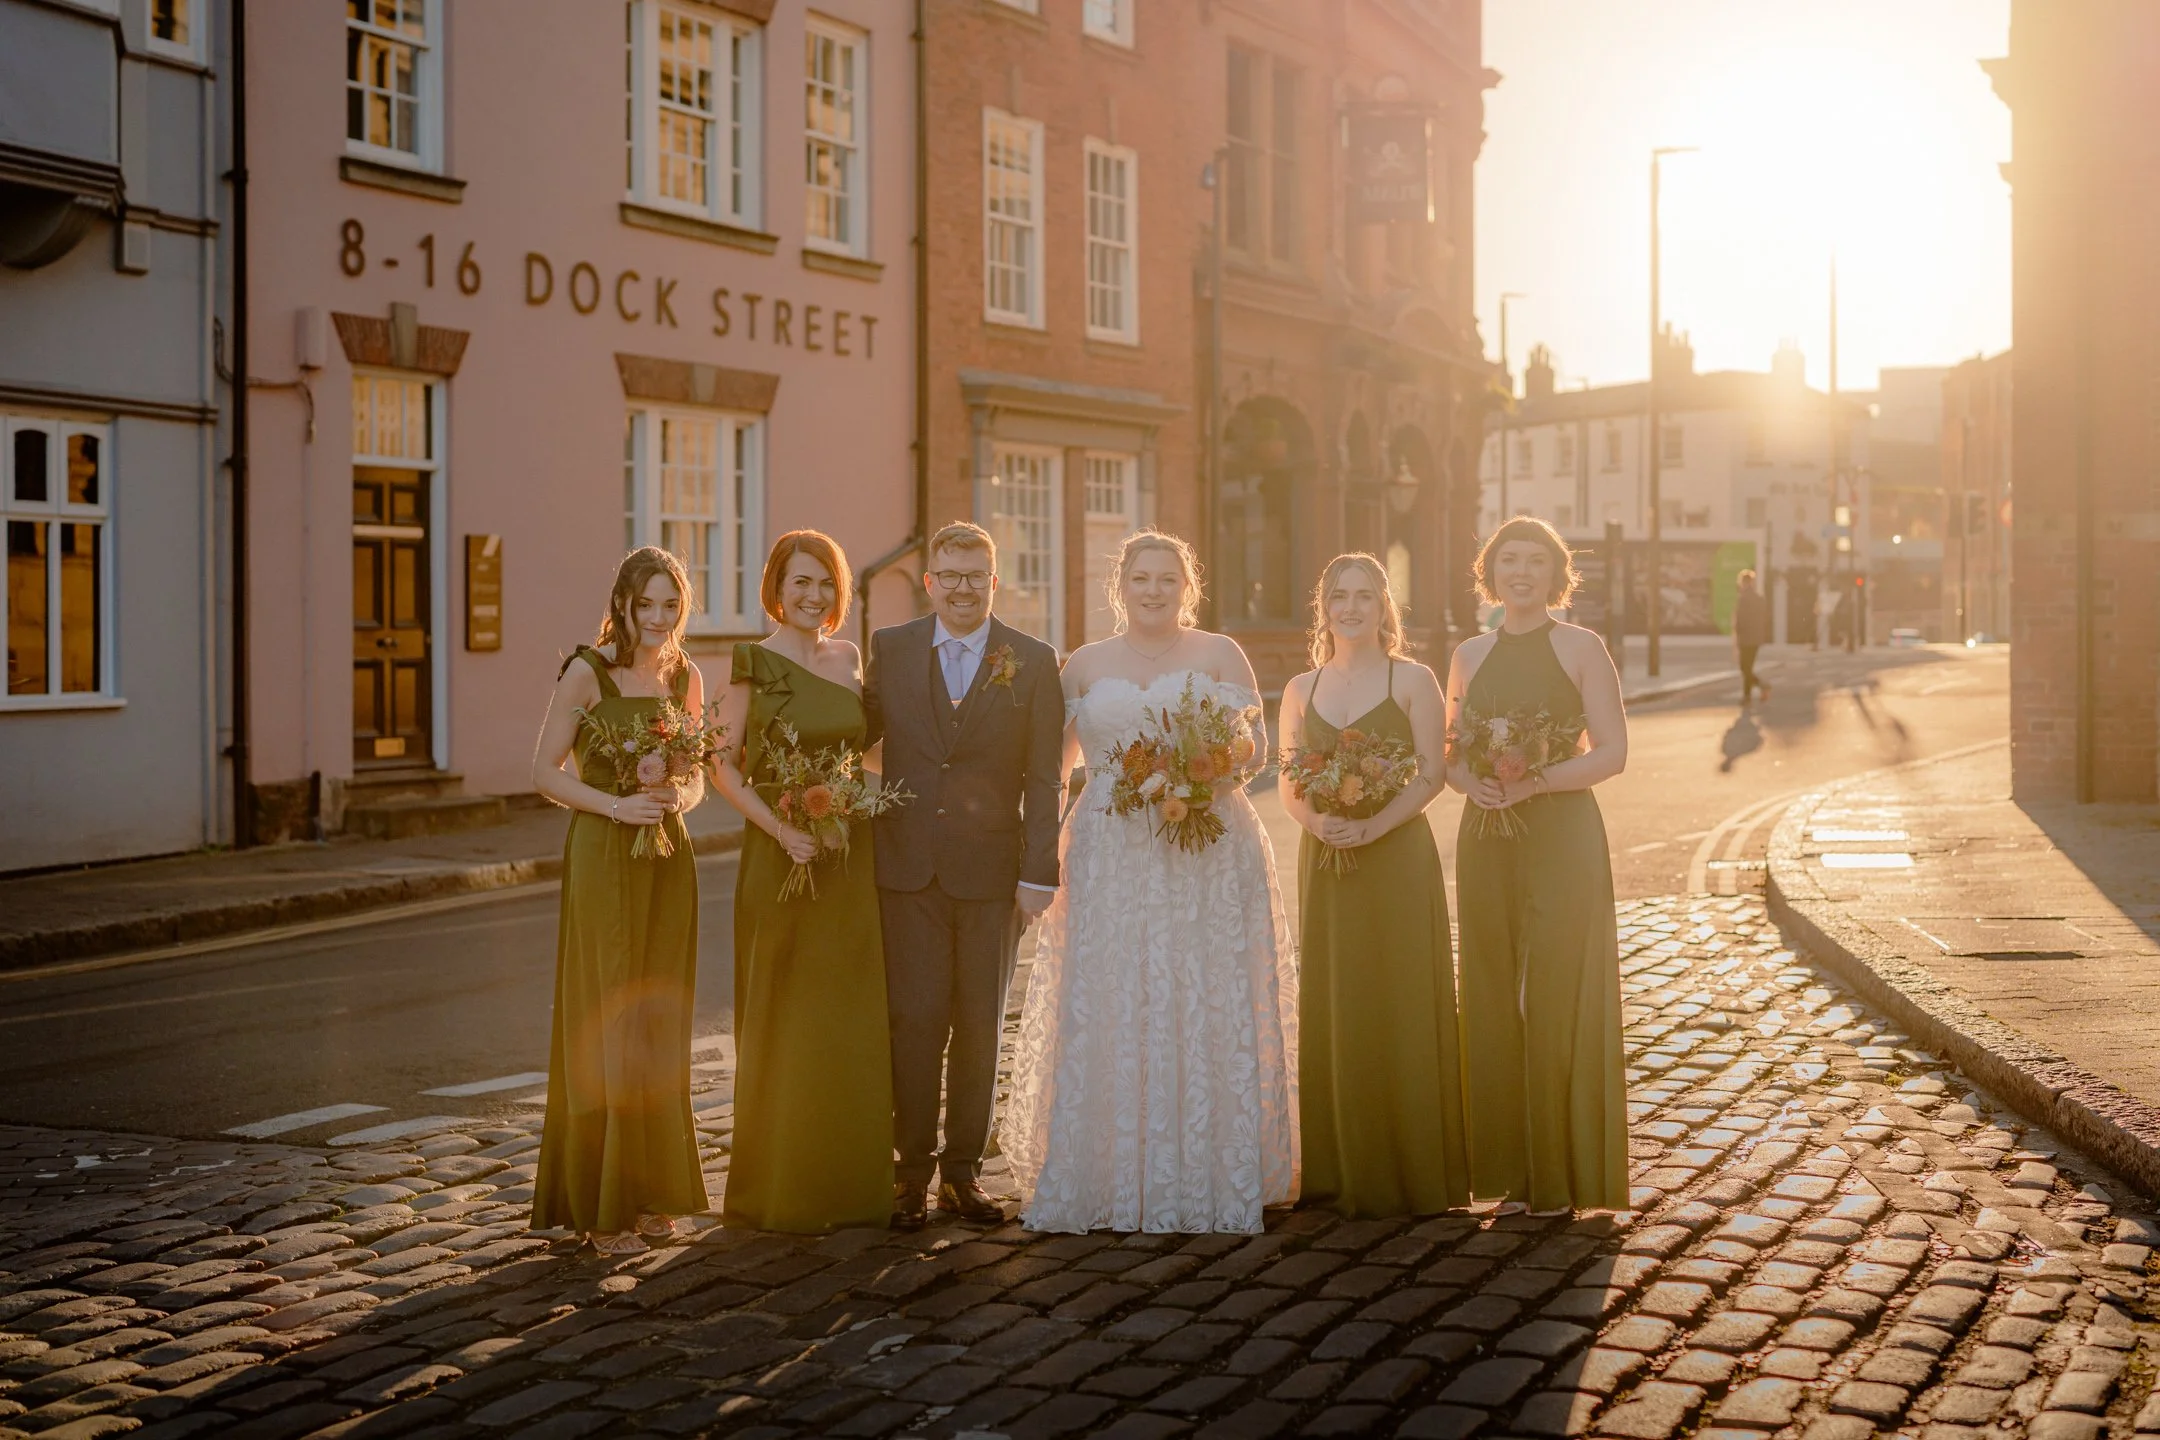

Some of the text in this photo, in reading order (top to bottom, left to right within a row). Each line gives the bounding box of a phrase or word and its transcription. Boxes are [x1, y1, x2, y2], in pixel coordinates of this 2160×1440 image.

[340, 218, 879, 360] 8-16 DOCK STREET
